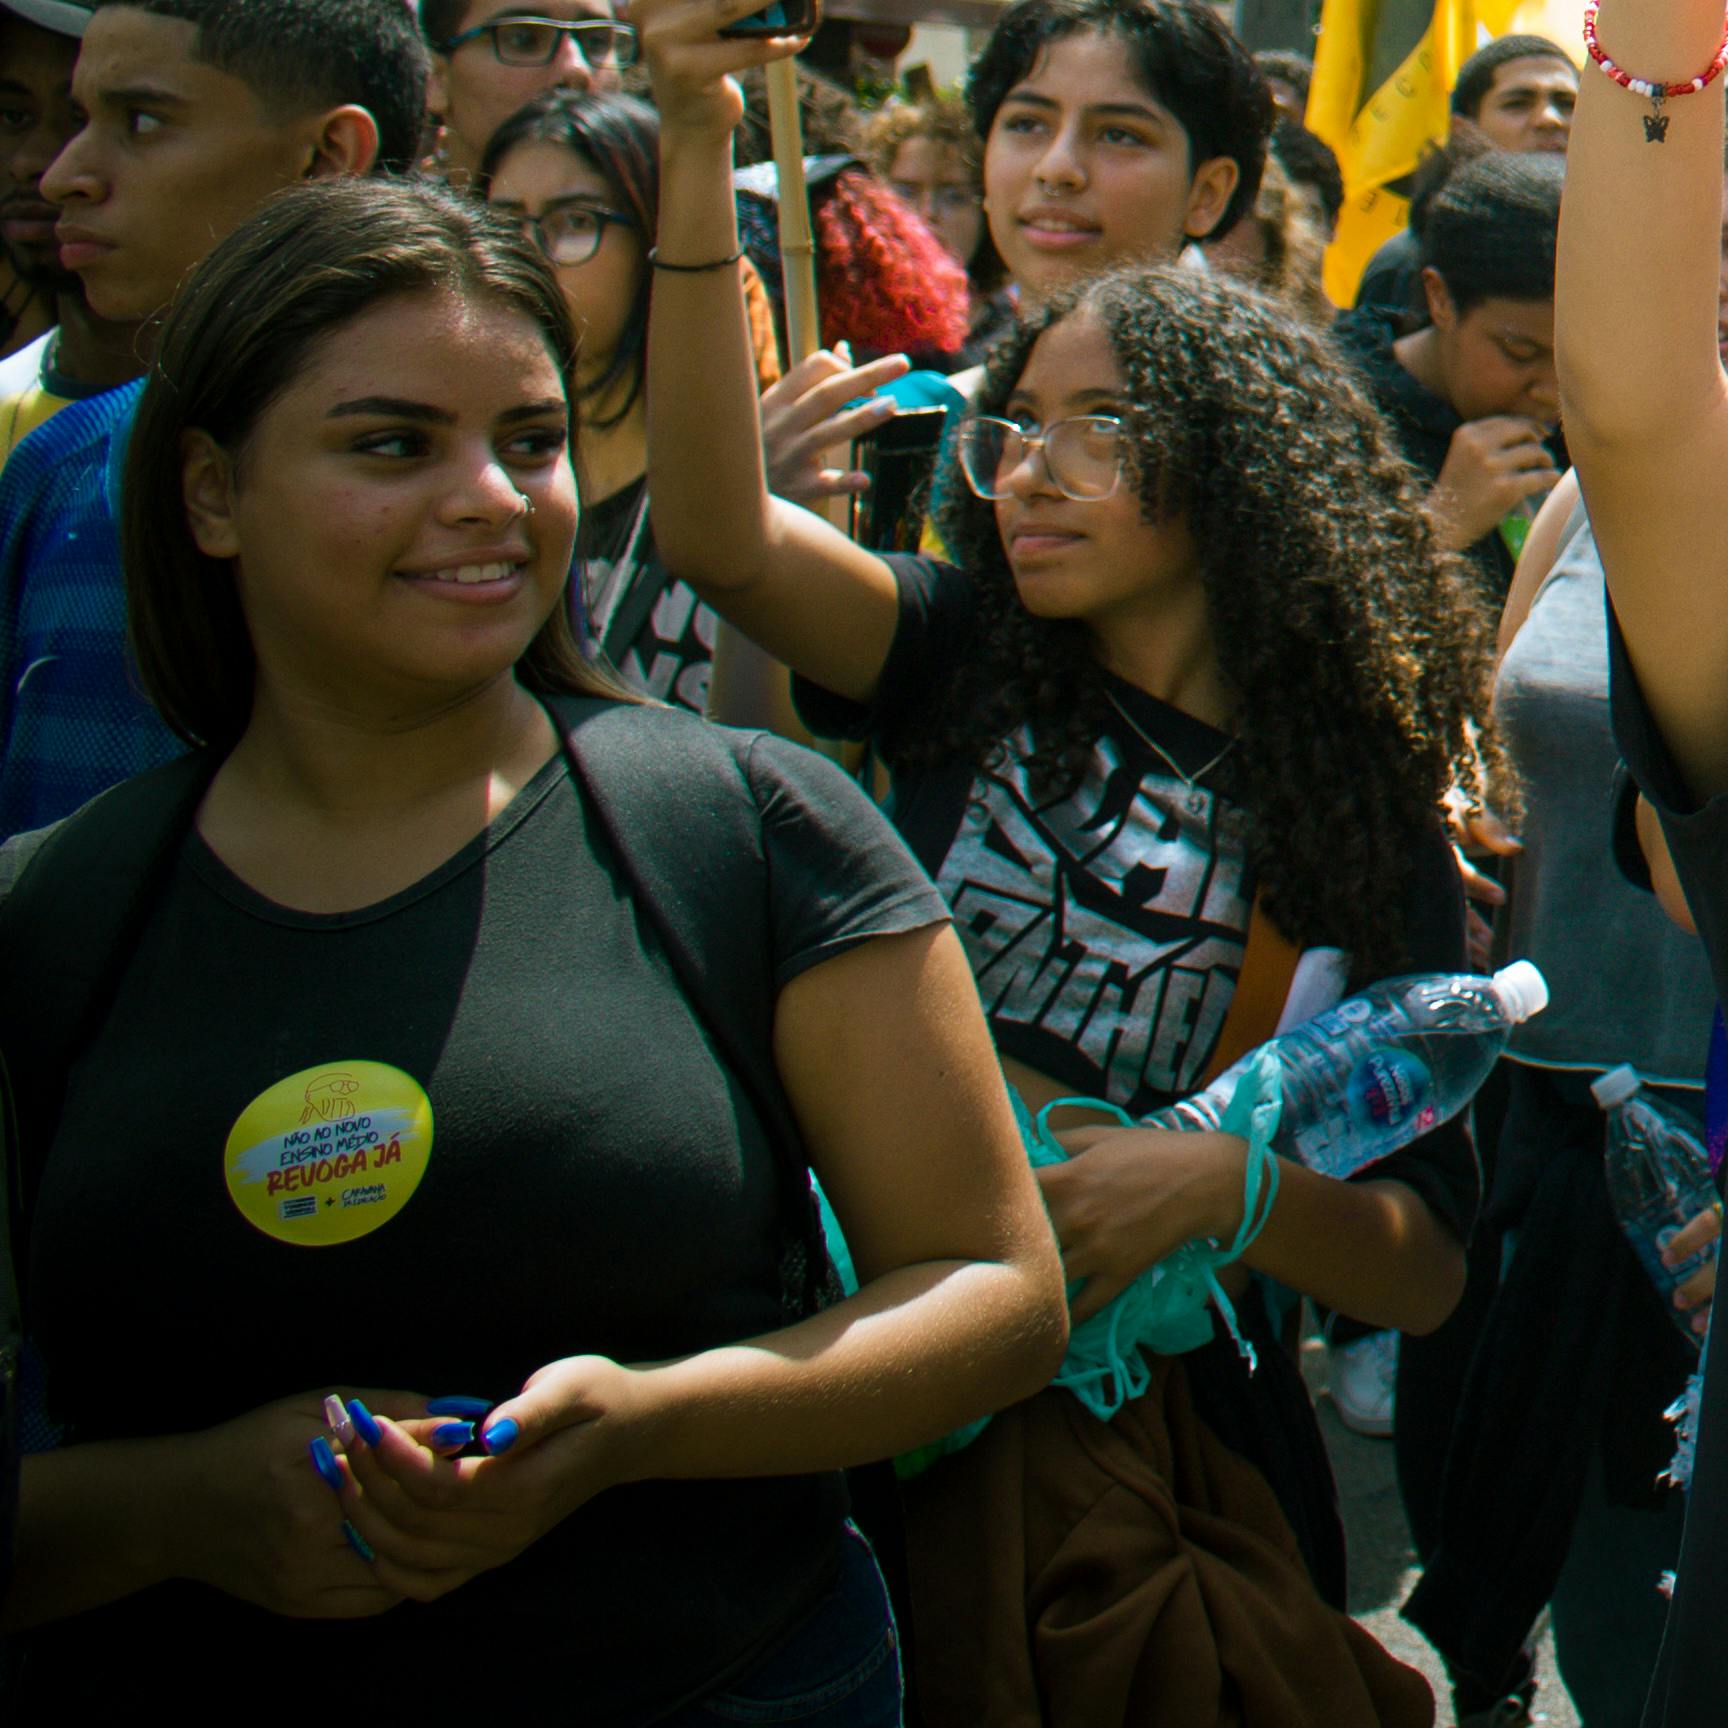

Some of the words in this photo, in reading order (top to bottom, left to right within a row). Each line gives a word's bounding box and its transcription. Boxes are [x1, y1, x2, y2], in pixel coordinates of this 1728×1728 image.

[280, 1142, 333, 1166] ENSINO
[336, 1131, 379, 1153] MÉDIO
[284, 1131, 311, 1149] NÃO
[313, 1126, 331, 1141] AO
[335, 1117, 371, 1135] NOVO
[266, 1148, 368, 1196] REVOGA
[373, 1131, 401, 1168] JÁ
